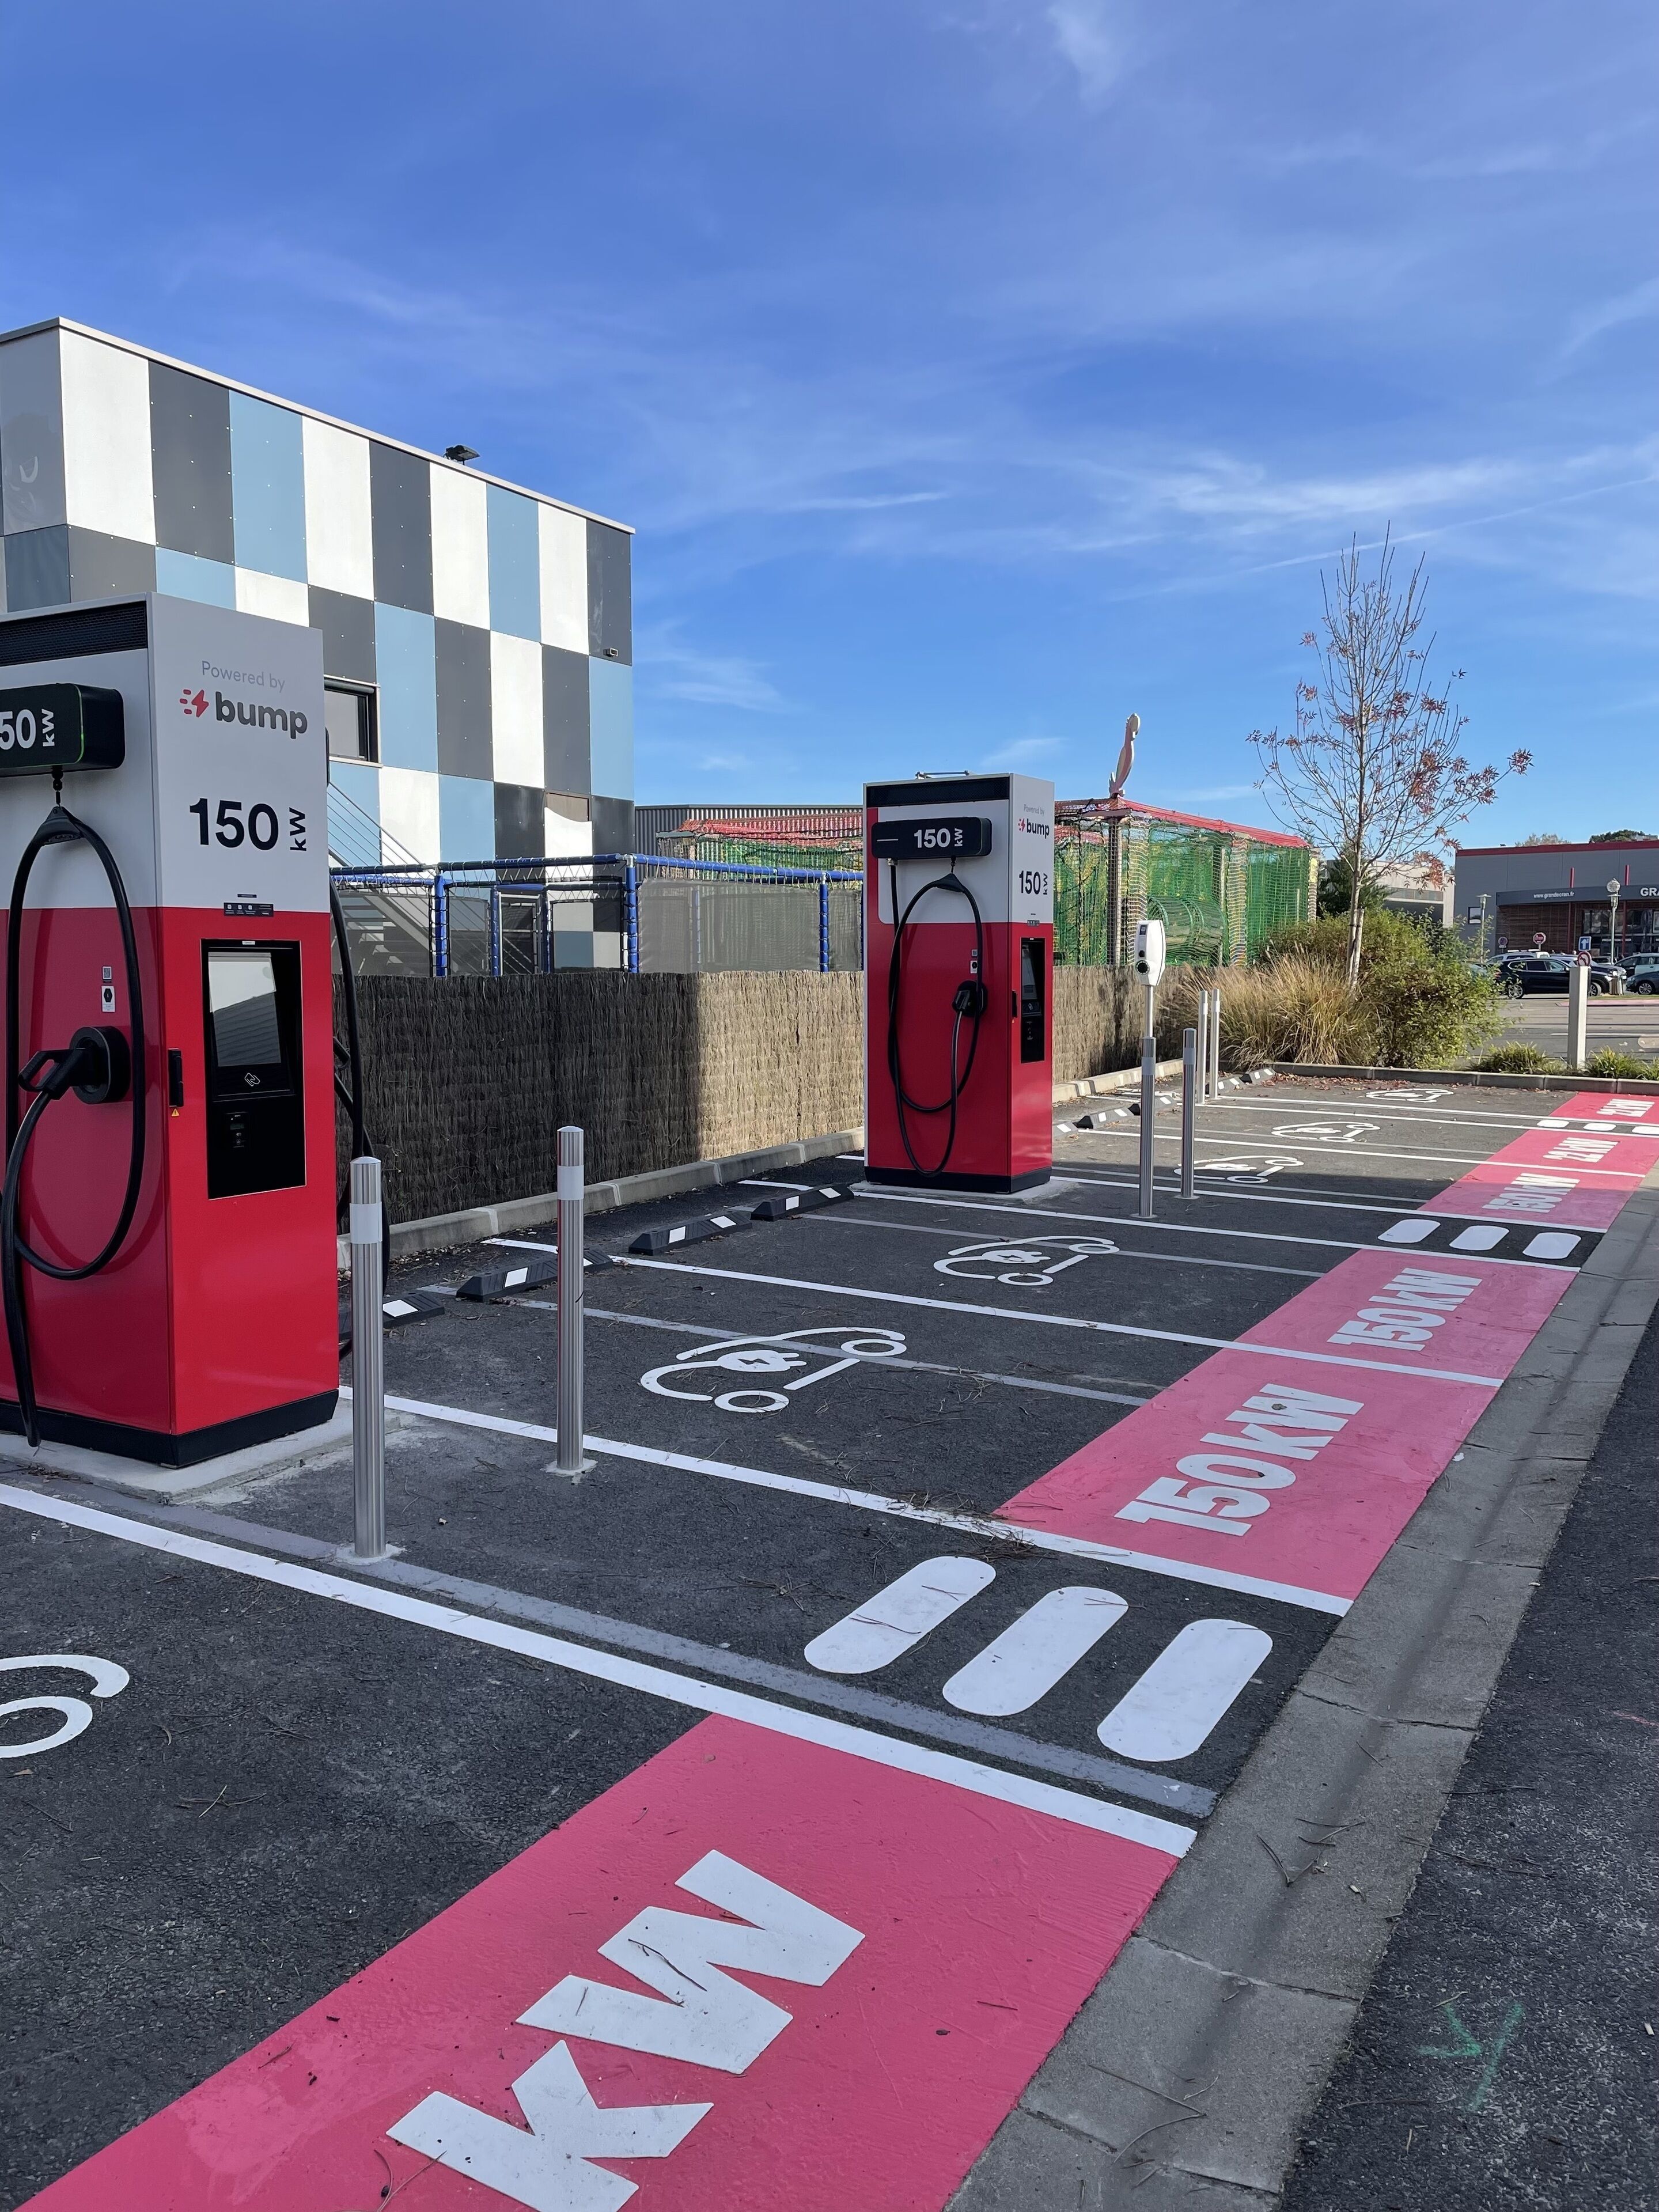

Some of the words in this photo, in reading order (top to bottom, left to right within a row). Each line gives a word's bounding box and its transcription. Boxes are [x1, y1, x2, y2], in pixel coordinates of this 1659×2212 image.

[202, 661, 264, 686] Powered
[270, 673, 286, 693] by
[215, 691, 308, 739] bump
[41, 709, 55, 747] kW
[1023, 804, 1040, 815] Powered
[1040, 807, 1045, 816] by
[189, 798, 279, 851] 150
[289, 807, 307, 851] kW
[1027, 818, 1050, 839] bump
[914, 828, 951, 849] 150
[954, 828, 963, 847] kW
[1018, 870, 1041, 895] 150
[1043, 873, 1048, 895] kW
[1640, 887, 1659, 896] GR
